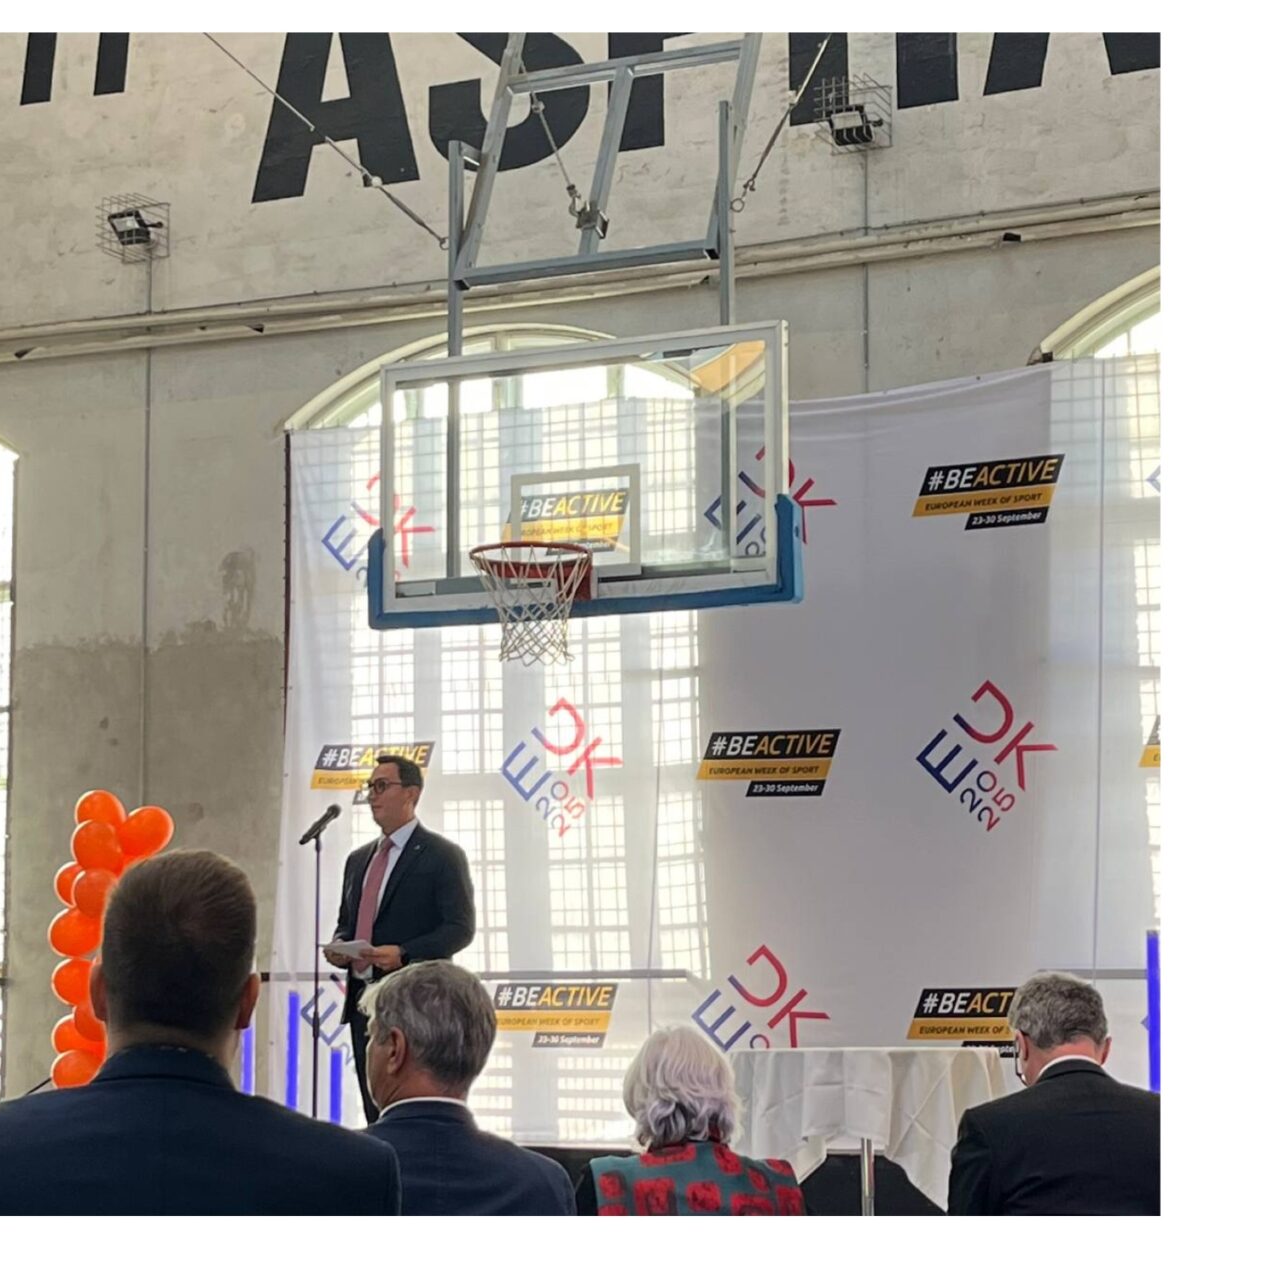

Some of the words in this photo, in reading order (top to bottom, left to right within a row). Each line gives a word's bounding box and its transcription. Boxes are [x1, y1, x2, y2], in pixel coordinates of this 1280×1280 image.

[928, 458, 1059, 492] #BEACTIVE
[925, 499, 971, 512] EUROPEAN
[973, 497, 997, 507] WEEK
[1000, 495, 1012, 504] OF
[1014, 493, 1043, 504] SPORT
[971, 514, 997, 526] 23-30
[997, 512, 1043, 524] September
[711, 733, 835, 757] #BEACTIVE
[709, 766, 754, 775] EUROPEAN
[755, 766, 777, 775] WEEK
[779, 766, 791, 774] OF
[791, 765, 820, 774] SPORT
[752, 783, 776, 793] 23-30
[776, 782, 820, 794] September
[497, 985, 613, 1008] #BEACTIVE
[922, 991, 1014, 1014] #BEACT
[574, 1017, 601, 1026] SPORT
[919, 1026, 965, 1035] EUROPEAN
[966, 1026, 990, 1035] WEEK
[992, 1026, 1004, 1035] OF
